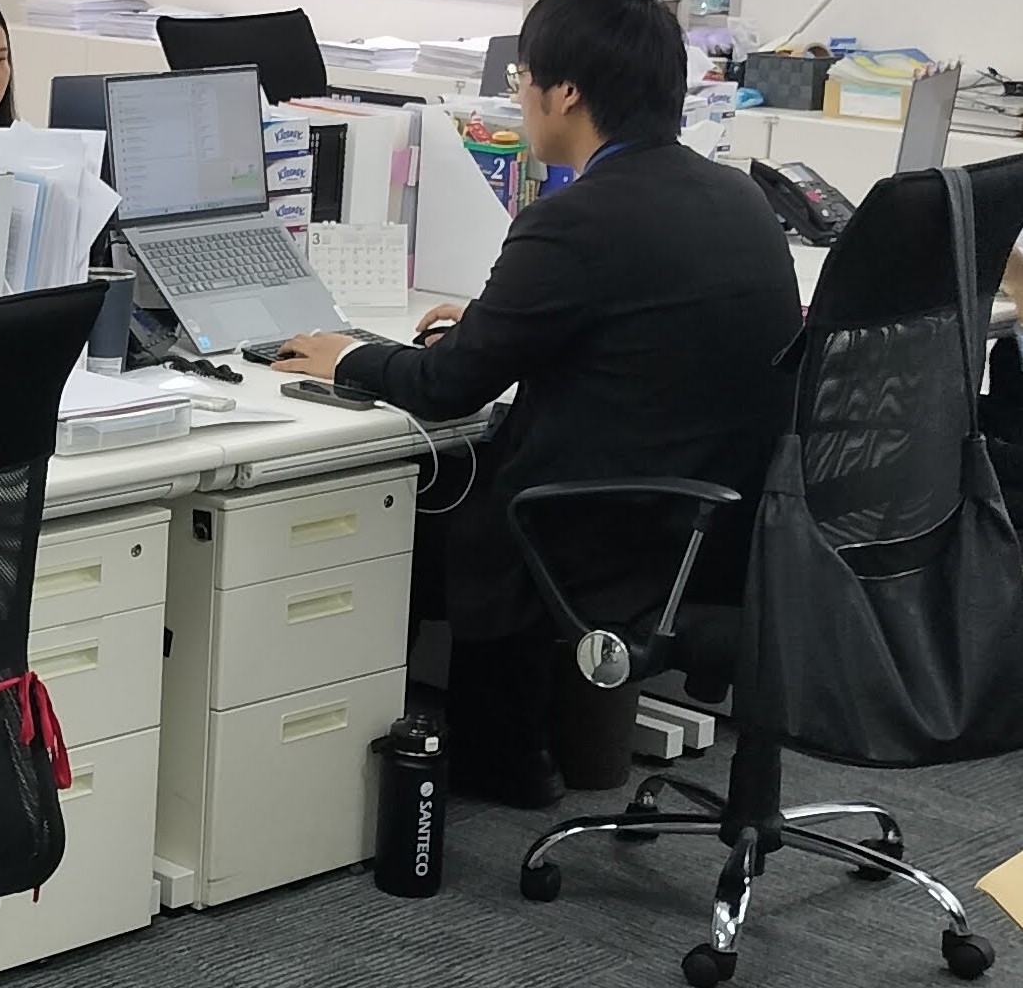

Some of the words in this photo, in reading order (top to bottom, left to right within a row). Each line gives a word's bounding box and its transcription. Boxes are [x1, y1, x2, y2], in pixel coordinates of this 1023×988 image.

[490, 157, 506, 180] 2
[312, 232, 321, 245] 3
[415, 800, 433, 877] SANTECO
